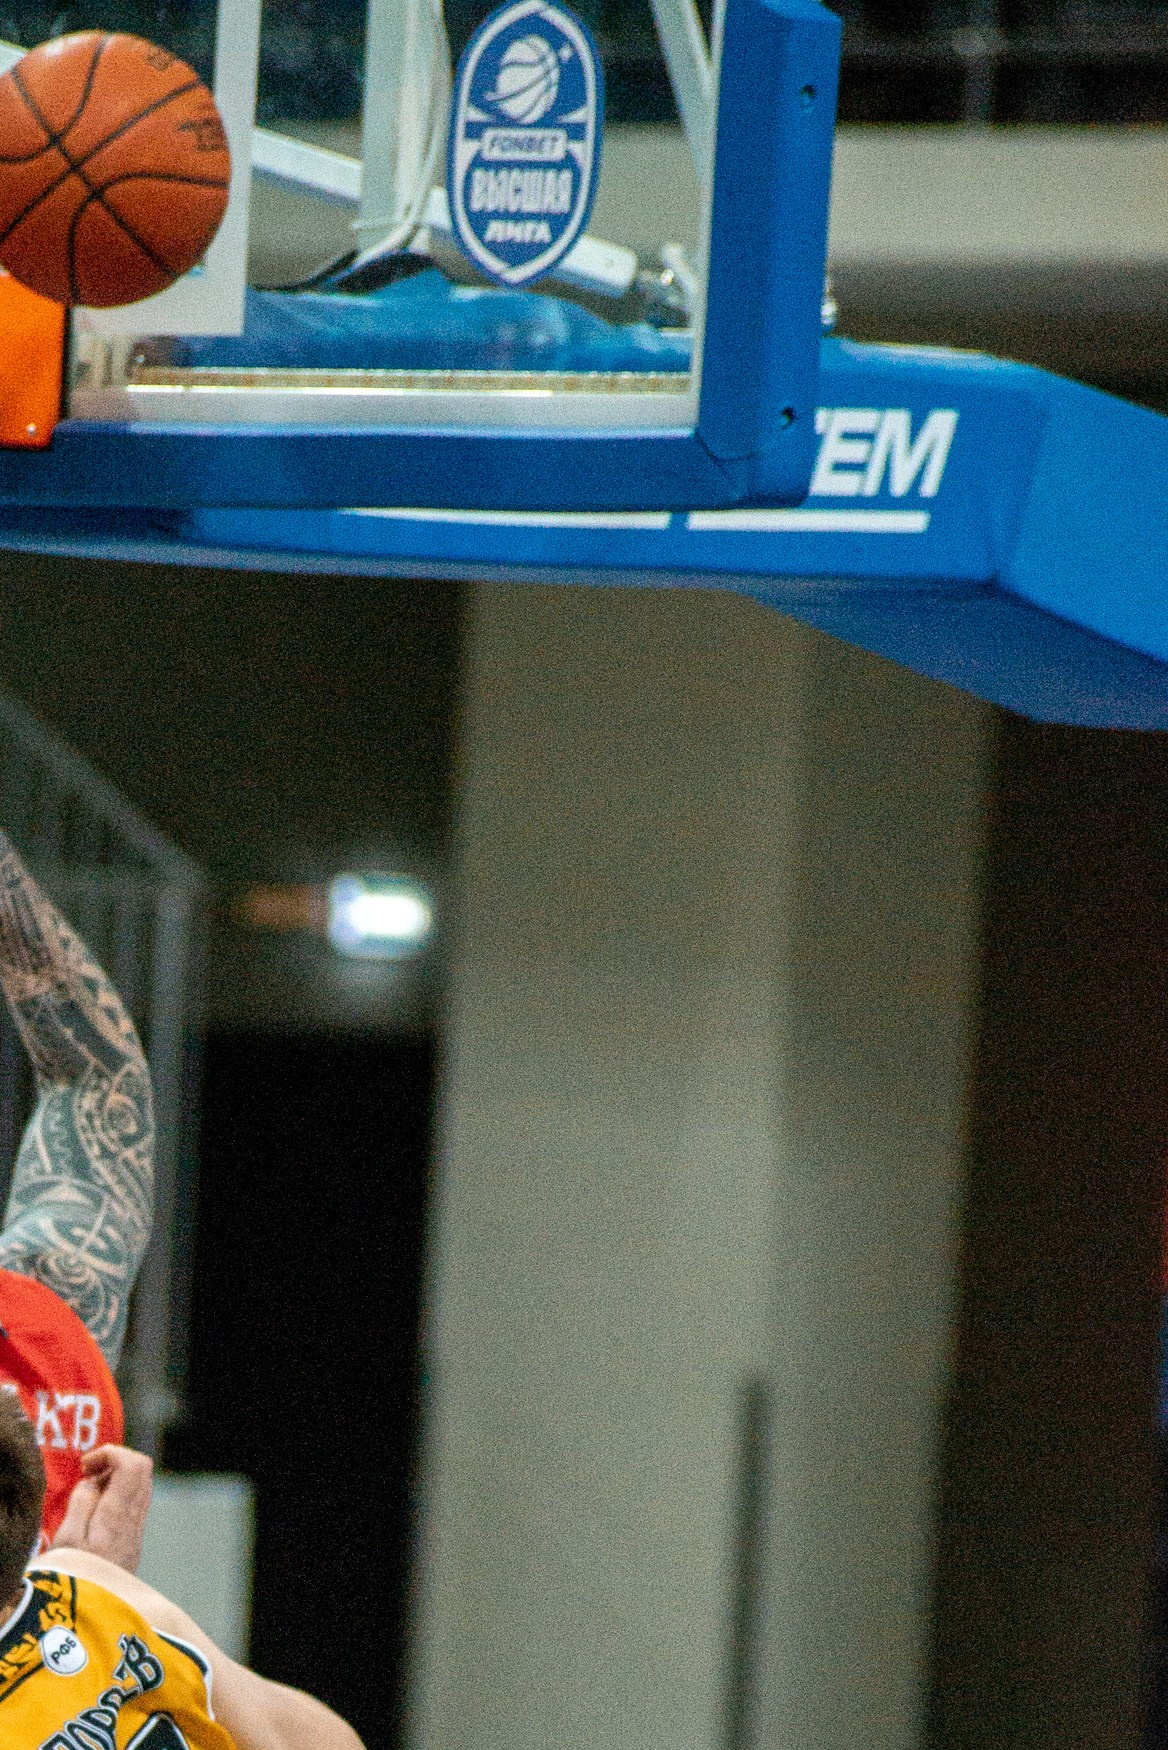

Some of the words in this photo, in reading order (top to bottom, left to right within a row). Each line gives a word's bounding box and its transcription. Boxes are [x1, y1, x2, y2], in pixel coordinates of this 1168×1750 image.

[470, 167, 574, 214] ВЫСШАЯ
[809, 406, 960, 497] EM
[50, 1636, 78, 1665] РФБ
